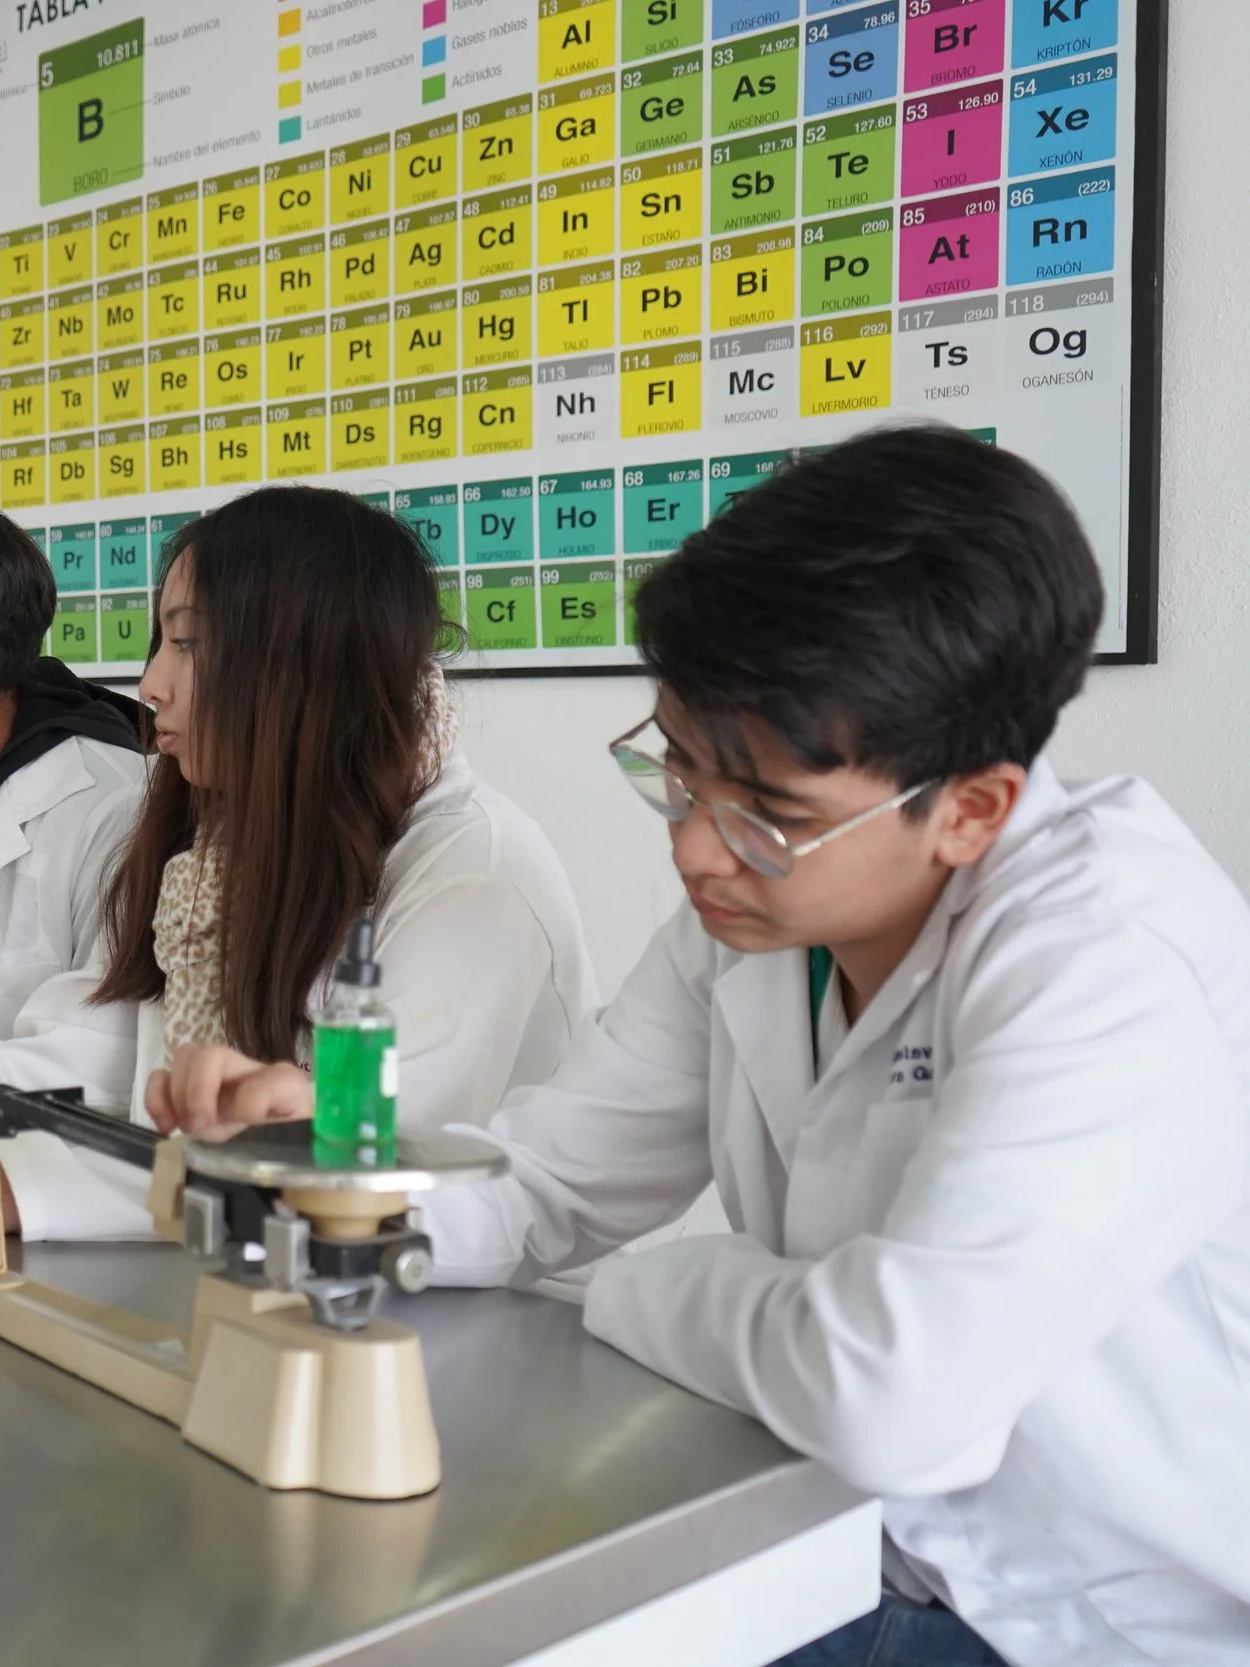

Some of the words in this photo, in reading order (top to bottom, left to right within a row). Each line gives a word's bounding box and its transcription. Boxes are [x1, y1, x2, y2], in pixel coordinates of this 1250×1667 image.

[542, 0, 558, 16] 13
[648, 0, 676, 26] Si
[909, 1, 931, 17] 35
[1043, 0, 1088, 27] Kr
[731, 11, 780, 32] FÓSFORO
[864, 12, 895, 28] 78.96
[452, 31, 486, 50] Gases
[490, 18, 528, 39] nobles
[562, 20, 590, 49] Al
[809, 24, 829, 42] 34
[934, 24, 977, 54] Br
[97, 38, 138, 68] 10.811
[646, 38, 678, 56] SILICIO
[760, 38, 795, 56] 74.922
[1037, 38, 1091, 60] KRIPTÓN
[714, 49, 733, 66] 33
[829, 51, 874, 78] Se
[42, 62, 53, 86] 5
[554, 58, 598, 78] ALUMINIO
[672, 62, 700, 77] 72.64
[931, 65, 976, 85] BROMO
[1070, 67, 1112, 85] 131.29
[623, 72, 642, 88] 32
[732, 74, 776, 102] As
[1014, 79, 1036, 98] 54
[540, 92, 555, 110] 31
[827, 89, 872, 109] SELENIO
[958, 93, 998, 111] 126.90
[640, 97, 684, 122] Ge
[906, 103, 928, 121] 53
[79, 98, 104, 143] B
[464, 112, 480, 128] 30
[556, 118, 596, 142] Ga
[728, 111, 779, 131] ARSÉNICO
[854, 116, 892, 133] 127.60
[1036, 106, 1089, 138] Xe
[636, 132, 687, 152] GERMANIO
[806, 125, 826, 144] 52
[947, 130, 954, 156] I
[480, 136, 513, 161] Zn
[714, 148, 730, 164] 51
[758, 138, 792, 154] 121.76
[410, 156, 442, 178] Cu
[562, 153, 589, 168] GALIO
[666, 160, 698, 174] 118.71
[828, 153, 869, 179] Te
[1039, 150, 1083, 169] XENÓN
[349, 170, 371, 194] Ni
[623, 166, 641, 182] 50
[934, 173, 966, 188] YODO
[732, 171, 774, 199] Sb
[1078, 180, 1110, 195] (222)
[279, 189, 311, 210] Co
[641, 192, 681, 218] Sn
[827, 193, 868, 210] TELURO
[1010, 188, 1034, 207] 86
[218, 204, 245, 225] Fe
[903, 207, 924, 226] 85
[966, 200, 995, 216] (210)
[158, 217, 187, 238] Mn
[563, 210, 588, 233] In
[724, 210, 780, 230] ANTIMONIO
[862, 219, 889, 235] (209)
[109, 231, 130, 250] Cr
[479, 222, 514, 250] Cd
[642, 230, 680, 246] ESTAÑO
[804, 227, 824, 245] 84
[1033, 218, 1087, 247] Rn
[409, 242, 441, 267] Ag
[713, 245, 731, 260] 83
[757, 238, 791, 253] 208.98
[928, 234, 969, 265] At
[346, 254, 375, 279] Pd
[623, 261, 641, 277] 82
[666, 256, 698, 270] 207.20
[824, 255, 869, 282] Po
[1037, 261, 1081, 278] RADÓN
[280, 269, 311, 292] Rh
[540, 276, 554, 291] 81
[737, 269, 767, 296] Bi
[926, 278, 970, 295] ASTATO
[218, 283, 246, 304] Ru
[642, 286, 682, 312] Pb
[822, 295, 870, 311] POLONIO
[1076, 291, 1108, 307] (294)
[562, 300, 588, 324] Tl
[1010, 295, 1044, 314] 118
[107, 306, 134, 326] Mo
[730, 310, 774, 326] BISMUTO
[903, 311, 933, 330] 117
[964, 307, 993, 323] (294)
[59, 317, 83, 337] Nb
[479, 314, 514, 341] Hg
[644, 326, 678, 340] PLOMO
[804, 326, 833, 344] 116
[860, 323, 887, 337] (292)
[409, 329, 441, 351] Au
[713, 342, 740, 358] 115
[1029, 327, 1087, 358] Og
[350, 339, 372, 362] Pt
[926, 342, 968, 369] Ts
[218, 361, 247, 381] Os
[289, 351, 304, 371] Ir
[624, 354, 650, 370] 114
[825, 358, 866, 383] Lv
[161, 372, 187, 391] Re
[541, 366, 566, 381] 113
[730, 369, 774, 395] Mc
[1023, 369, 1093, 388] OGANESÓN
[112, 380, 130, 399] W
[465, 376, 488, 392] 112
[648, 380, 674, 406] Fl
[924, 385, 969, 400] TÉNESO
[62, 390, 82, 408] Ta
[556, 392, 595, 417] Nh
[812, 396, 878, 414] LIVERMORIO
[479, 404, 514, 427] Cn
[724, 409, 778, 424] MOSCOVIO
[346, 423, 375, 445] Ds
[410, 414, 442, 439] Rg
[638, 420, 684, 434] FLEROVIO
[219, 440, 247, 461] Hs
[284, 432, 310, 452] Mt
[110, 456, 133, 477] Sg
[162, 448, 188, 468] Bh
[61, 462, 85, 481] Db
[625, 471, 643, 486] 68
[668, 470, 700, 482] 167.26
[557, 506, 597, 530] Ho
[647, 498, 680, 523] Er
[481, 514, 515, 540] Dy
[64, 552, 83, 569] Pr
[111, 547, 136, 565] Nd
[487, 600, 515, 623] Cf
[561, 597, 597, 619] Es
[119, 620, 131, 639] U
